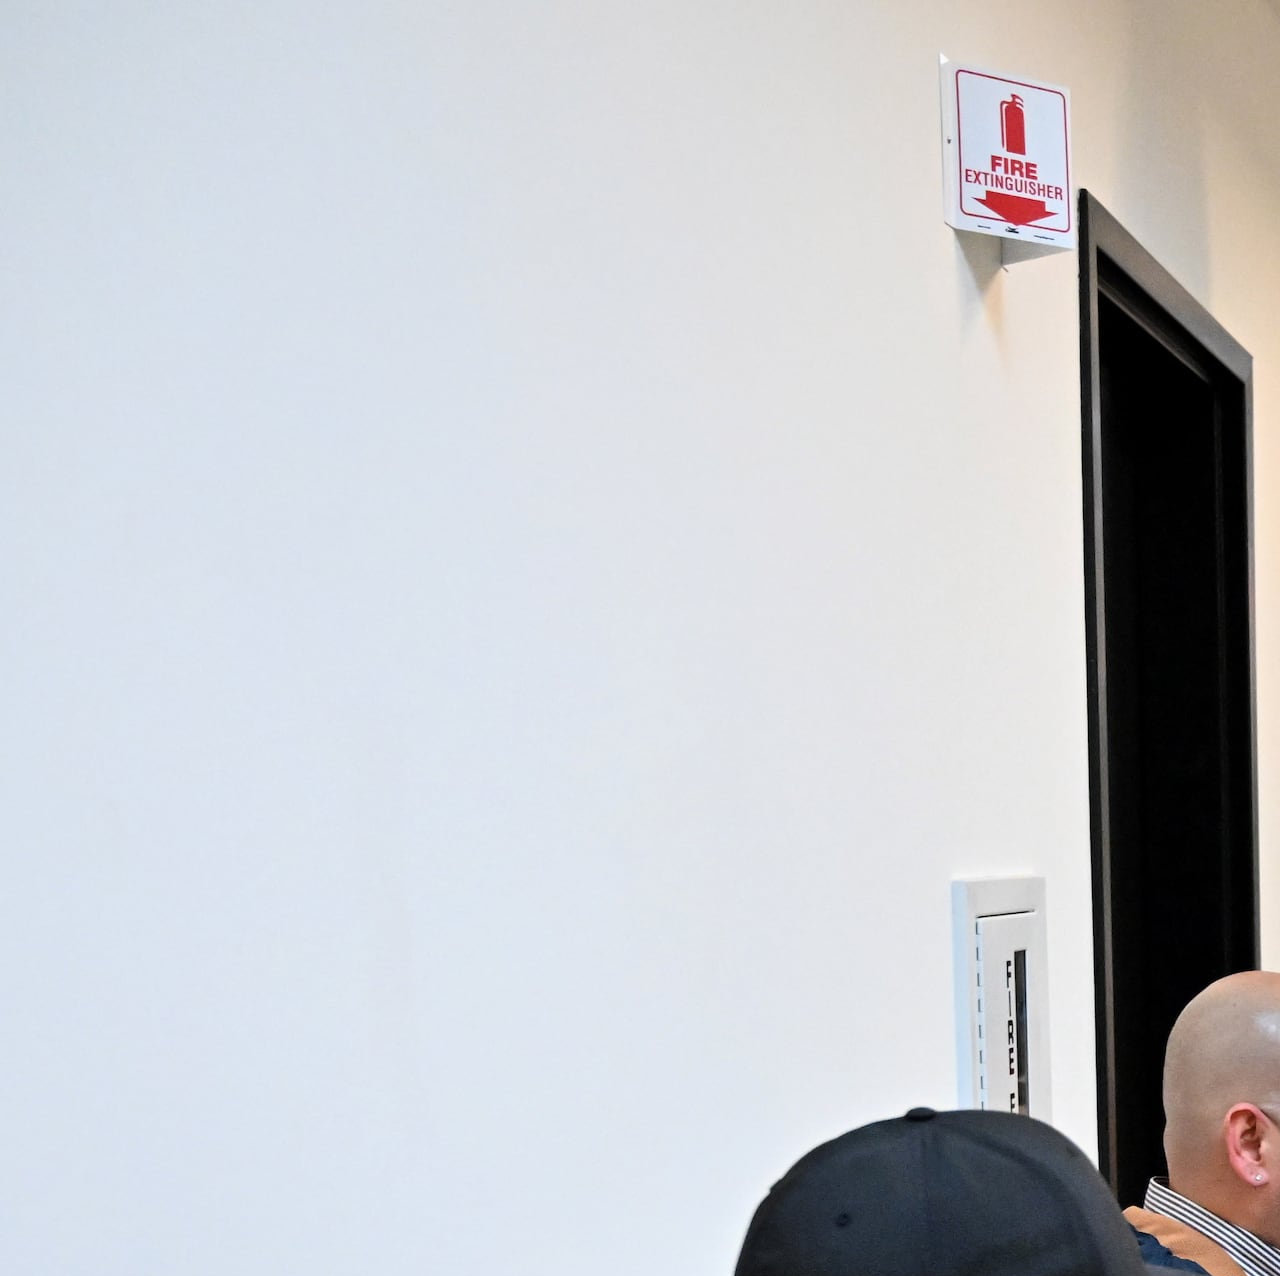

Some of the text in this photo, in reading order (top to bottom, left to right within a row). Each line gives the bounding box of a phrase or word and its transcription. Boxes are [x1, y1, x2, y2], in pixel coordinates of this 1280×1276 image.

[990, 155, 1038, 180] FIRE
[965, 168, 1063, 201] EXTINGUISHER
[1006, 960, 1015, 1075] FIRE
